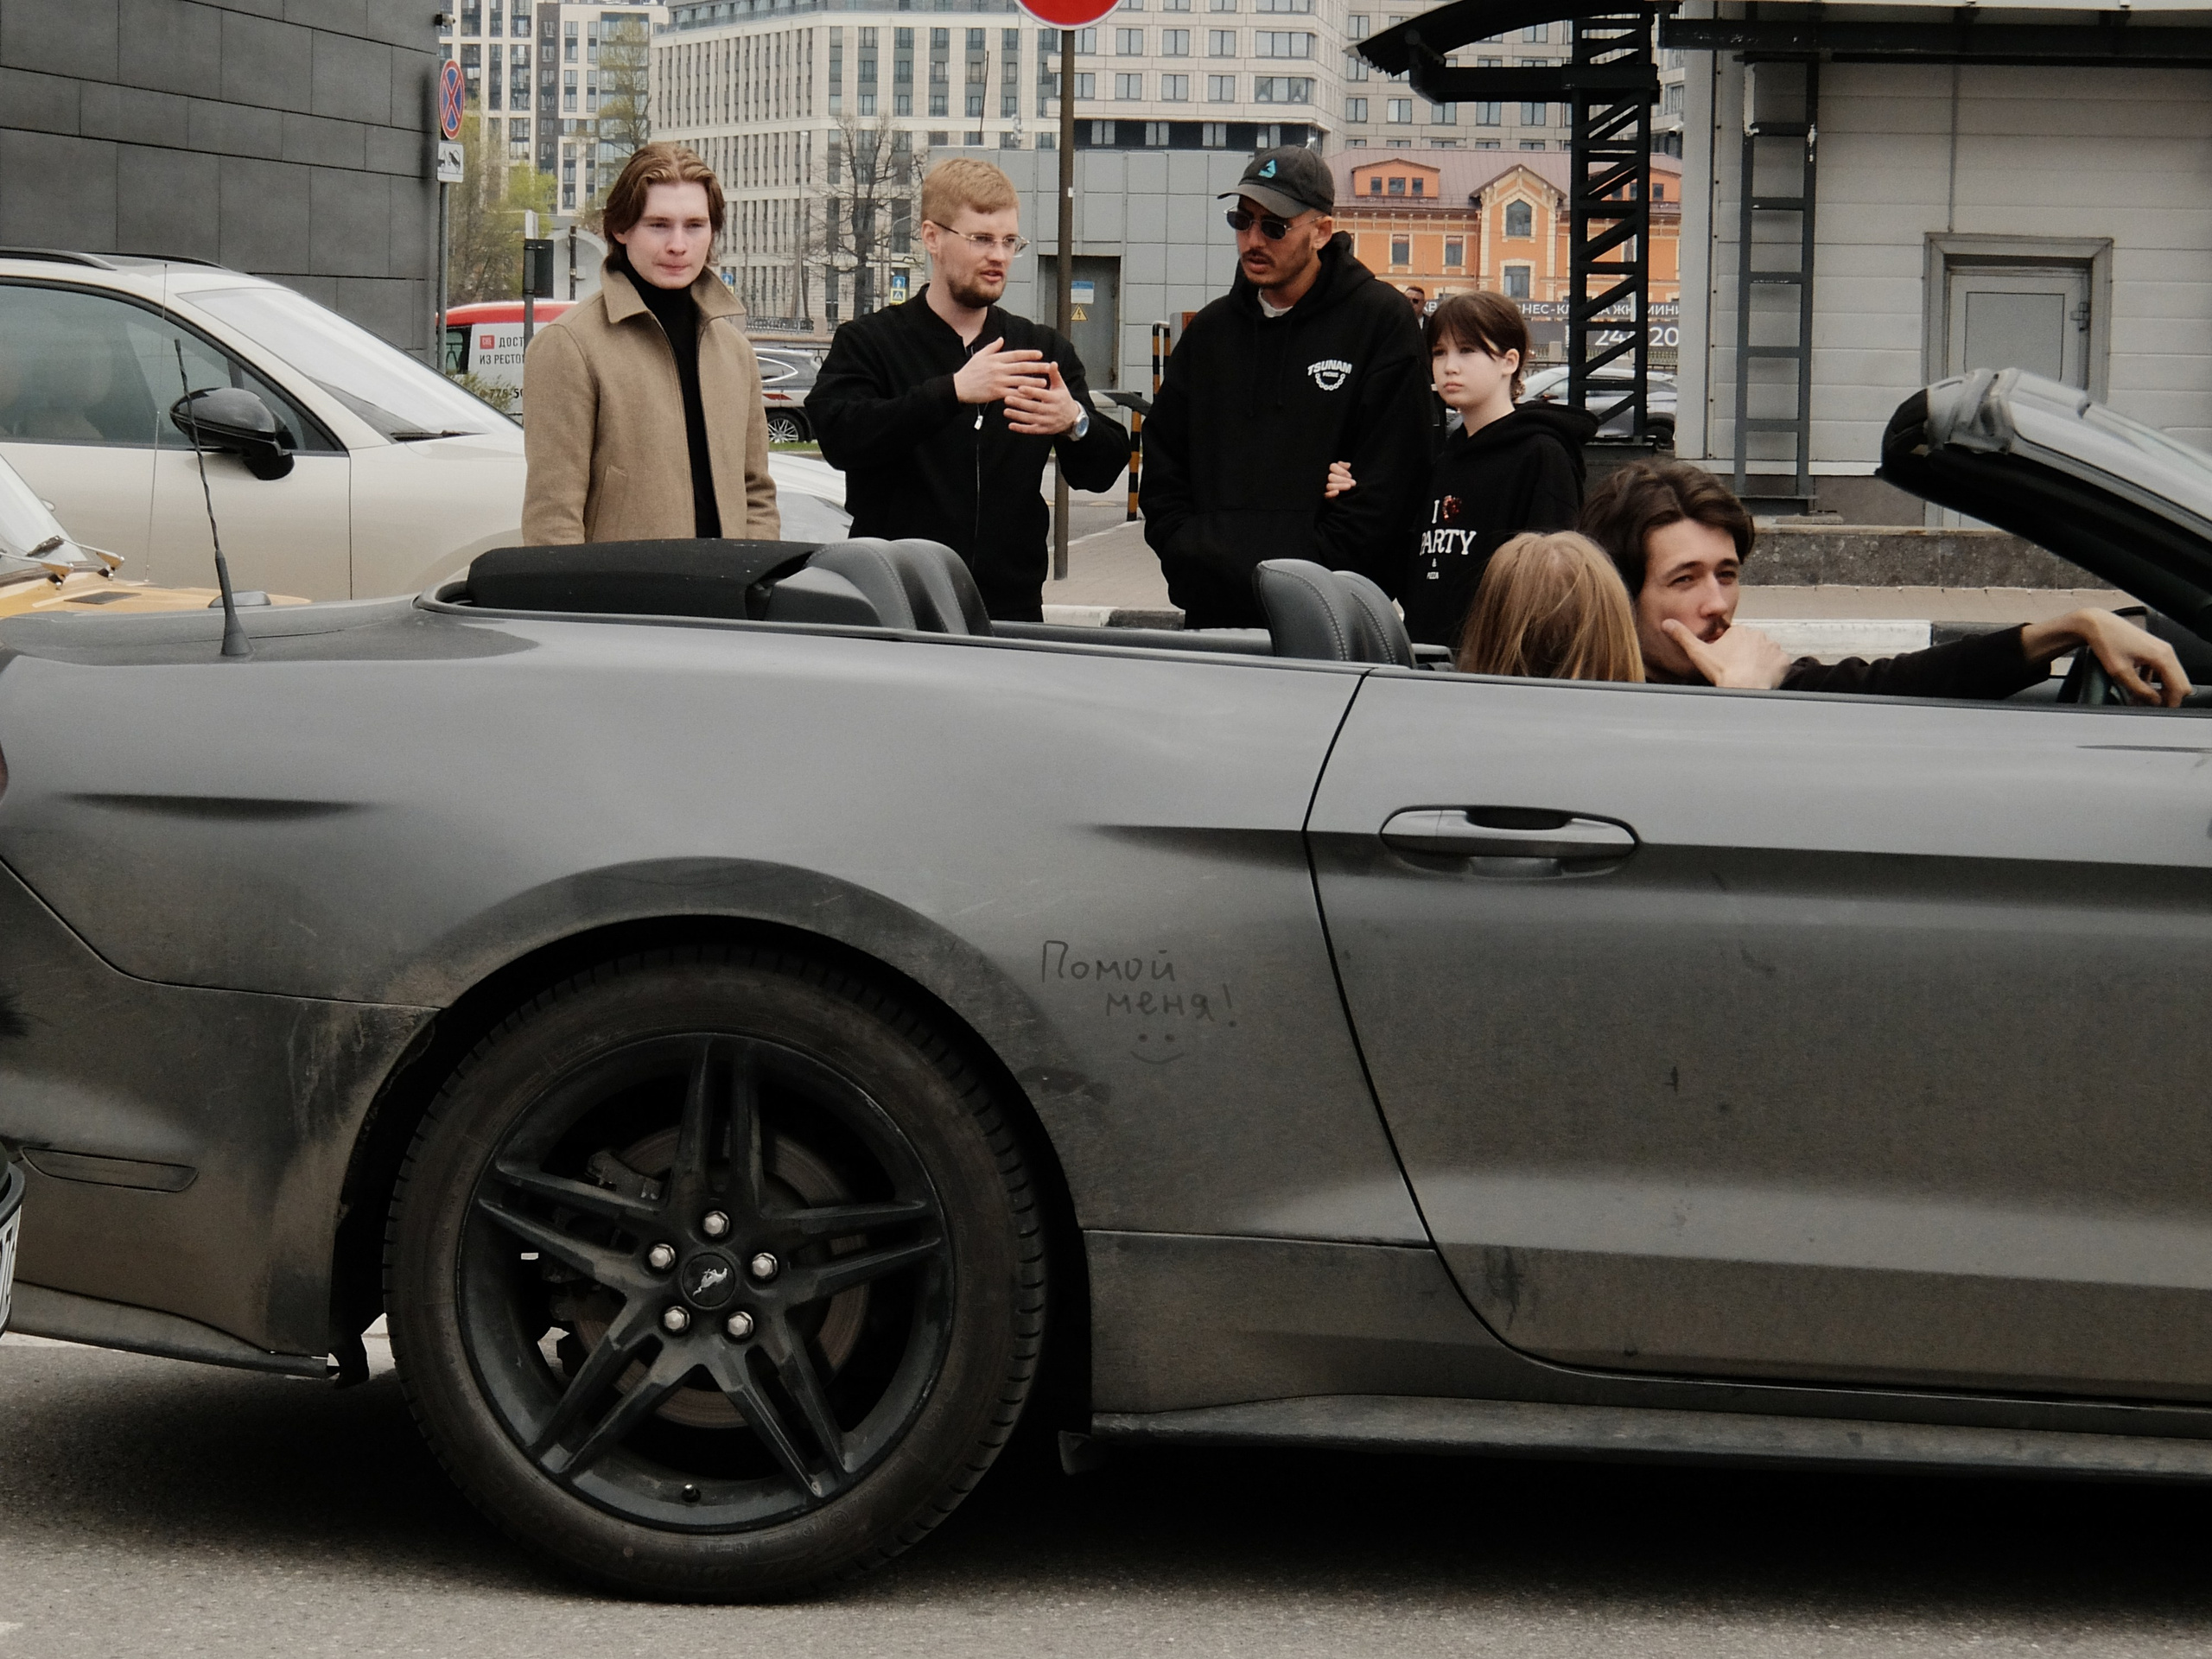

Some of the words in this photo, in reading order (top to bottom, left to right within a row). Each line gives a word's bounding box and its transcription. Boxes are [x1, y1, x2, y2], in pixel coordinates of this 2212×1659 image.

[480, 354, 492, 365] ИЗ
[1432, 499, 1440, 524] I
[1041, 939, 1176, 983] Помой
[1106, 982, 1237, 1028] меня!
